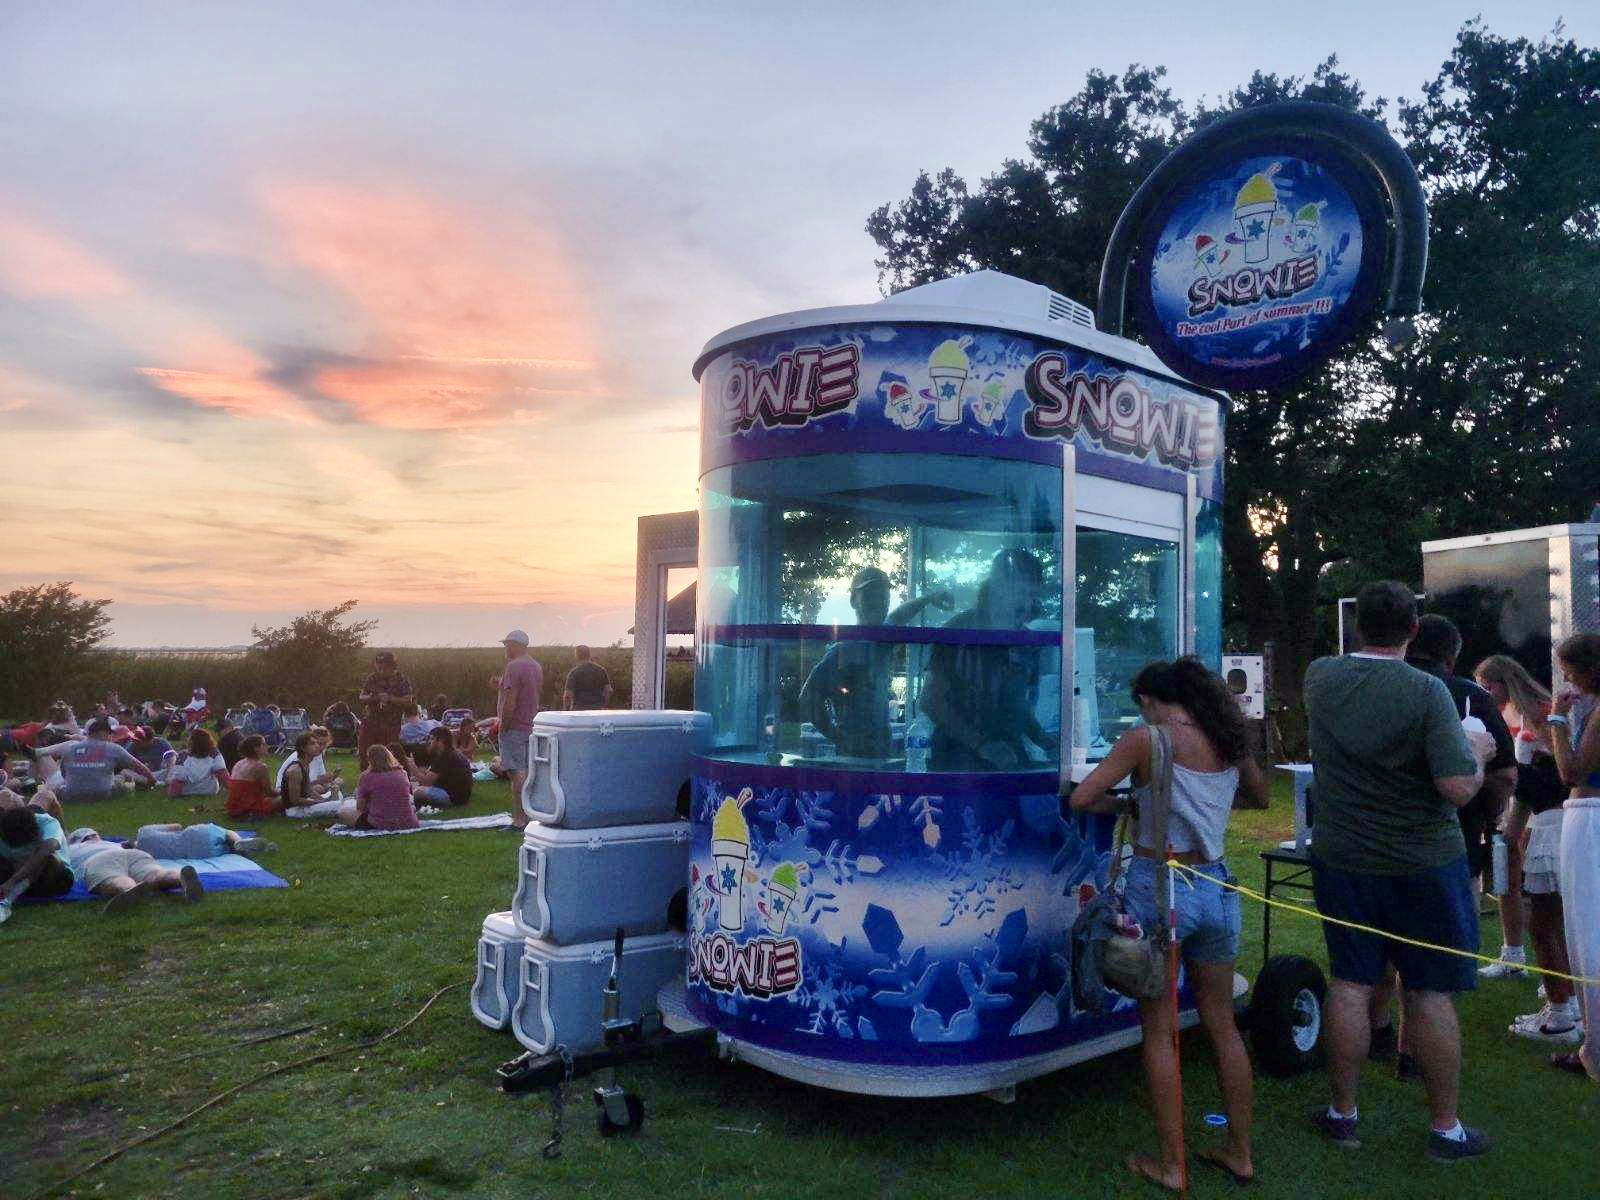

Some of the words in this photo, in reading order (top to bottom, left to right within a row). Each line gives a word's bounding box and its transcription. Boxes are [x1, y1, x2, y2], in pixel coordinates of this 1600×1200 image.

[1178, 322, 1199, 336] The
[1199, 320, 1221, 334] cool
[1222, 316, 1247, 330] Part
[1248, 310, 1260, 323] of
[1262, 303, 1313, 320] summer
[1188, 255, 1319, 317] SNOWIE
[721, 345, 860, 432] OWIE
[1024, 353, 1218, 469] SNOWIE
[688, 930, 800, 999] SNOWIE
